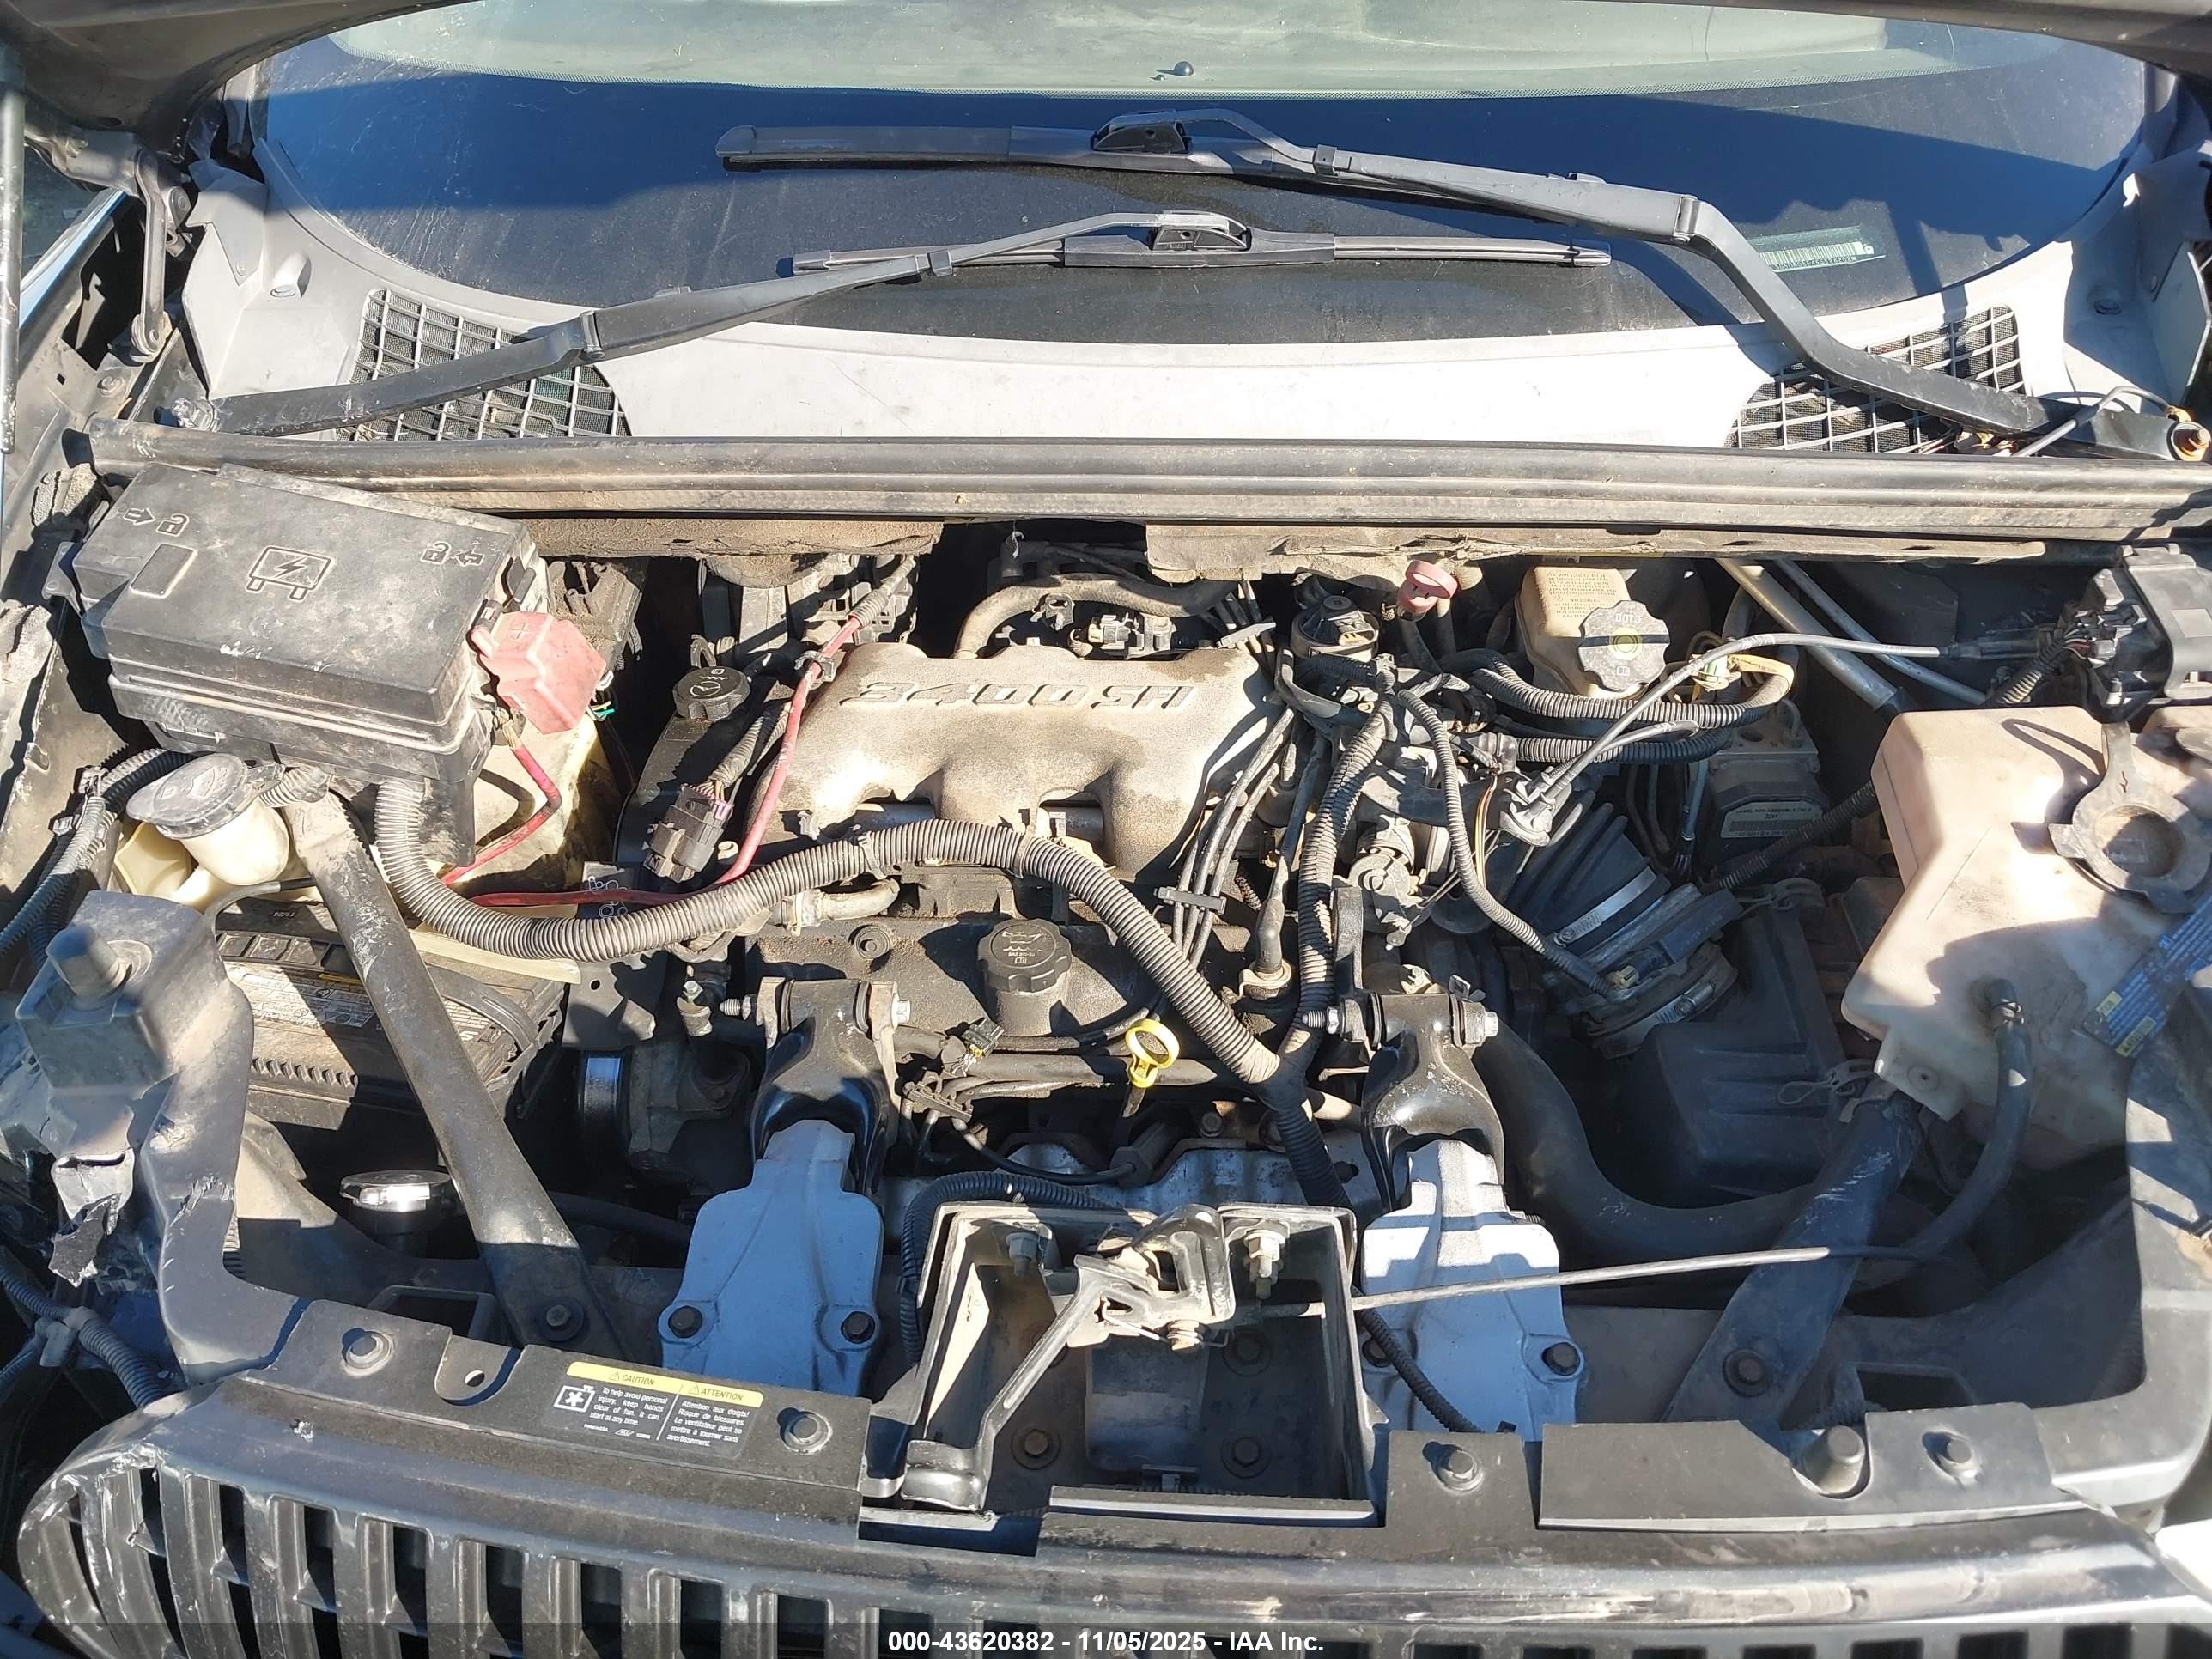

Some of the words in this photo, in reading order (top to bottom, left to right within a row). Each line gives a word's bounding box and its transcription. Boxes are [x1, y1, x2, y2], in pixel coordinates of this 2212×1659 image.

[839, 682, 1087, 706] 3400
[1091, 684, 1195, 709] SFI
[622, 1374, 655, 1385] CAUTION
[611, 1389, 623, 1397] help
[641, 1395, 668, 1404] personal
[701, 1388, 744, 1401] ATTENTION
[623, 1400, 638, 1408] keep
[644, 1403, 665, 1412] hands
[682, 1401, 710, 1411] Attention
[678, 1408, 700, 1418] Risque
[684, 1419, 717, 1430] ventilateur
[699, 1430, 723, 1439] tourner
